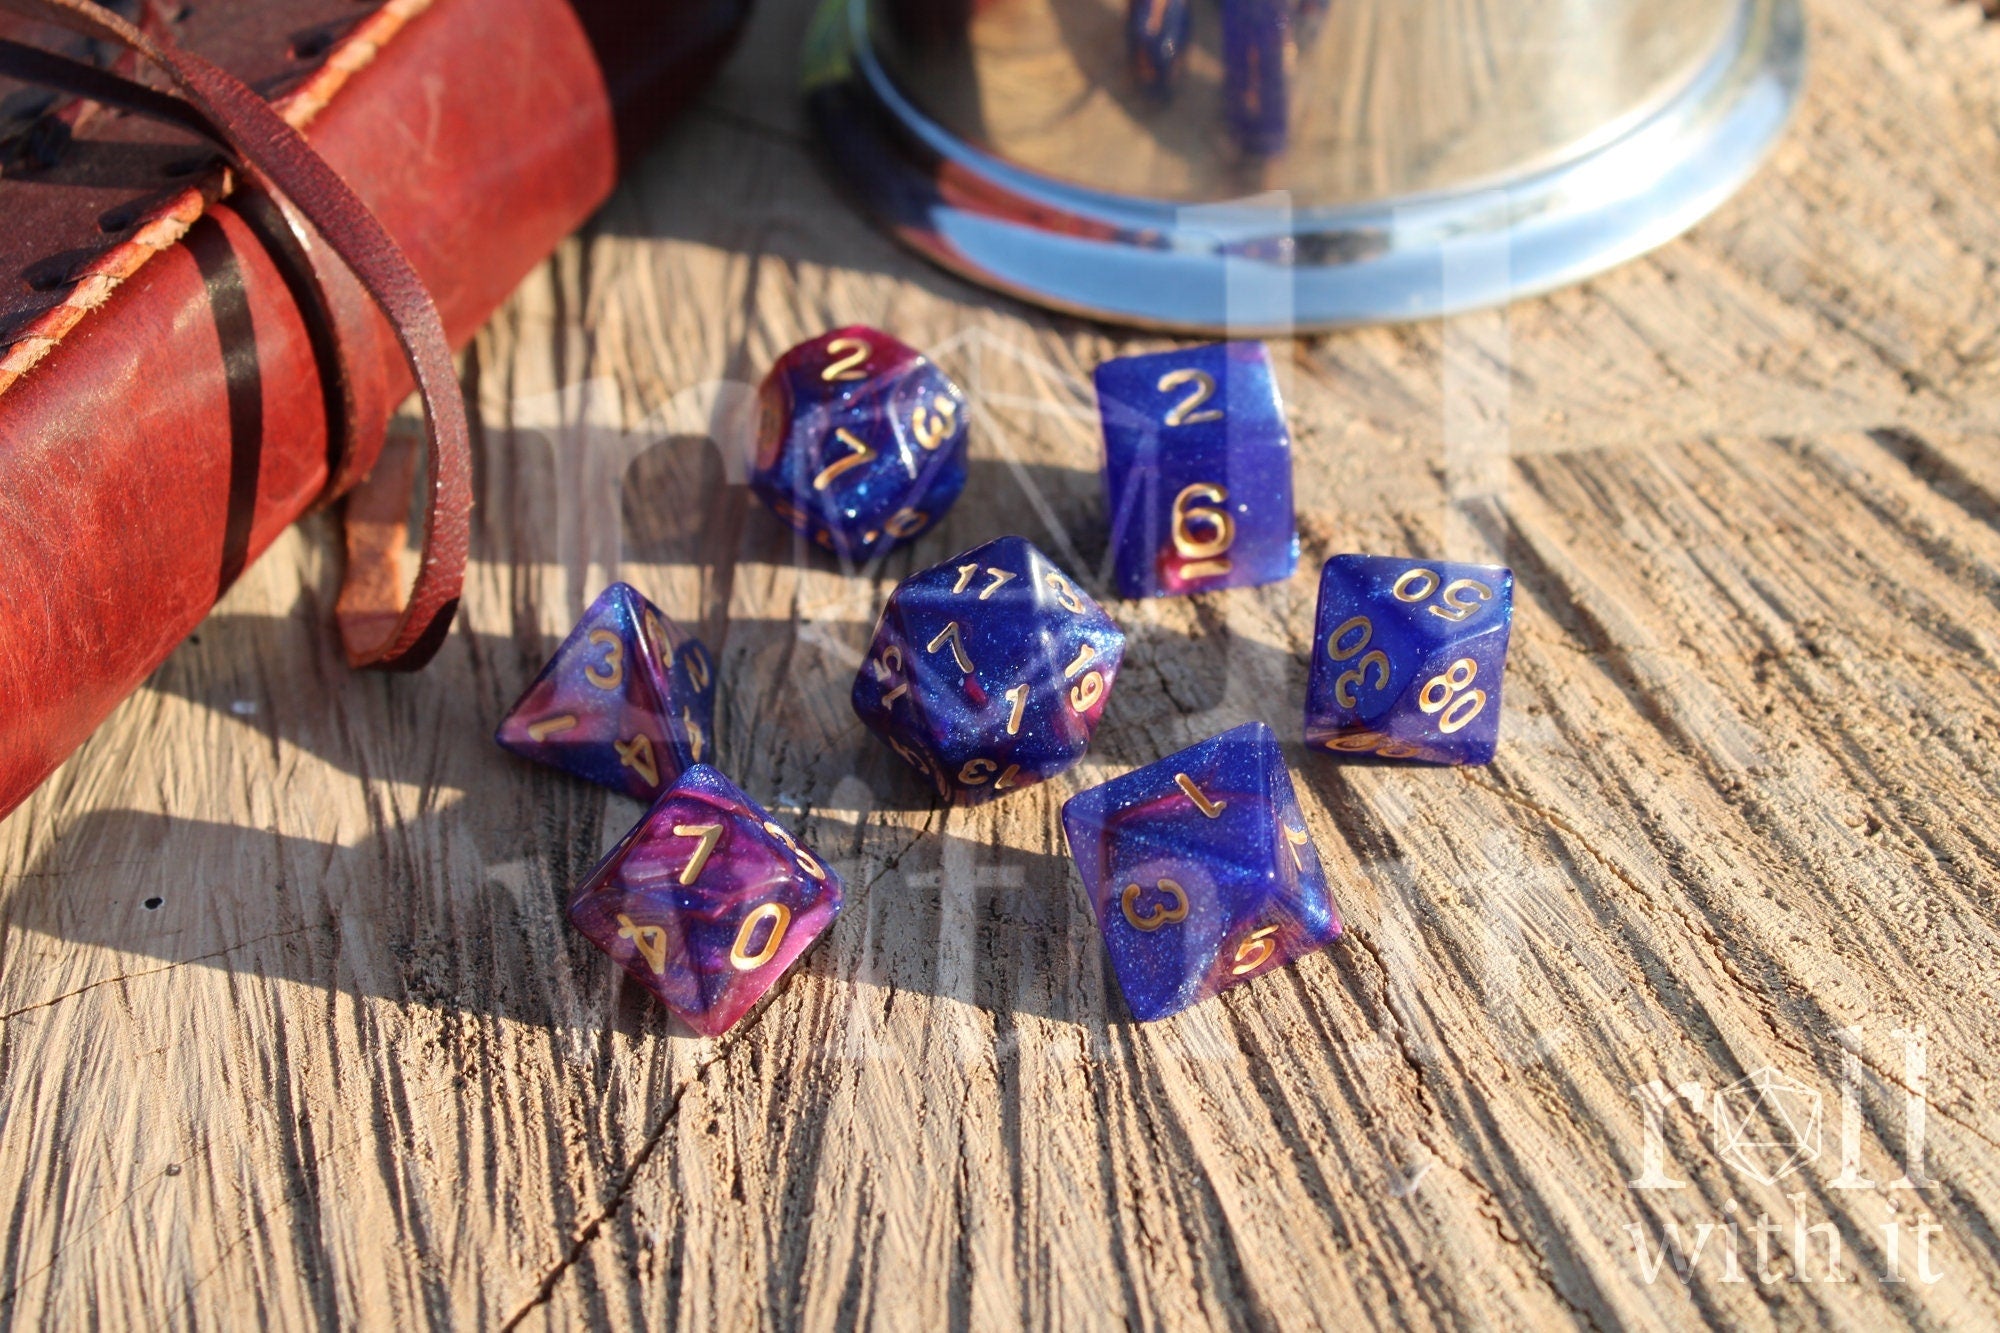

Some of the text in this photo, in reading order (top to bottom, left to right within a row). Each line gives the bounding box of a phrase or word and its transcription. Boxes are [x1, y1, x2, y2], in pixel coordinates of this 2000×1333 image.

[822, 338, 872, 381] 2
[913, 395, 956, 449] 3
[1158, 368, 1223, 426] 2
[1171, 483, 1235, 574] 6
[953, 563, 1017, 600] 17
[1393, 568, 1493, 622] 50
[585, 629, 624, 690] 3
[927, 621, 974, 673] 7
[1327, 615, 1390, 708] 30
[873, 645, 908, 710] 15
[1065, 644, 1104, 712] 19
[1419, 658, 1487, 734] 80
[529, 715, 577, 742] 1
[1006, 684, 1030, 734] 1
[614, 734, 659, 787] 4
[957, 758, 1020, 789] 13
[1175, 773, 1227, 818] 1
[673, 824, 724, 885] 7
[1121, 879, 1190, 932] 3
[617, 914, 668, 974] 4
[730, 903, 791, 970] 0
[1232, 925, 1280, 975] 5
